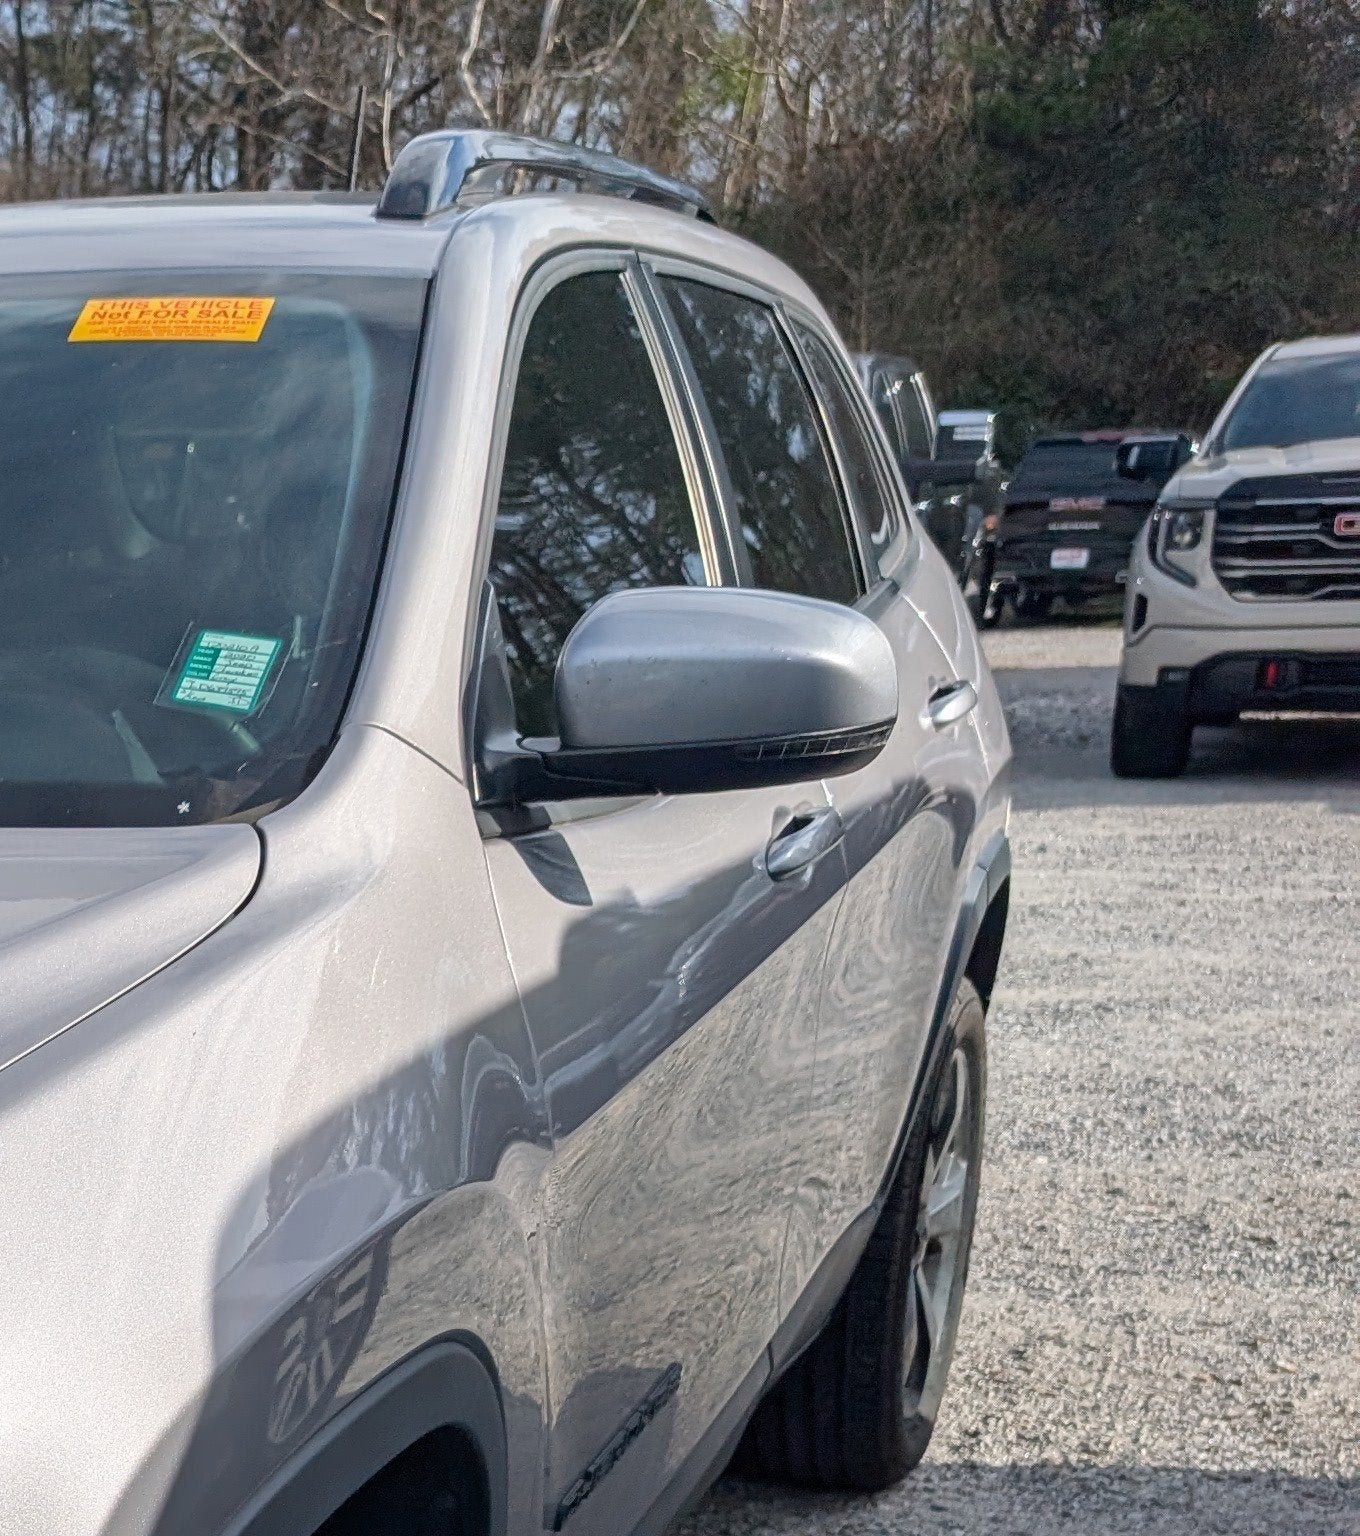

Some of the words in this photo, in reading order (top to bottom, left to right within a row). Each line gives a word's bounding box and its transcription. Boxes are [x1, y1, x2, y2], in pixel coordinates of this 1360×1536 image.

[99, 300, 149, 310] THIS
[159, 300, 262, 310] VEHICLE
[91, 310, 131, 320] Not
[138, 309, 189, 319] FOR
[197, 309, 263, 319] SALE
